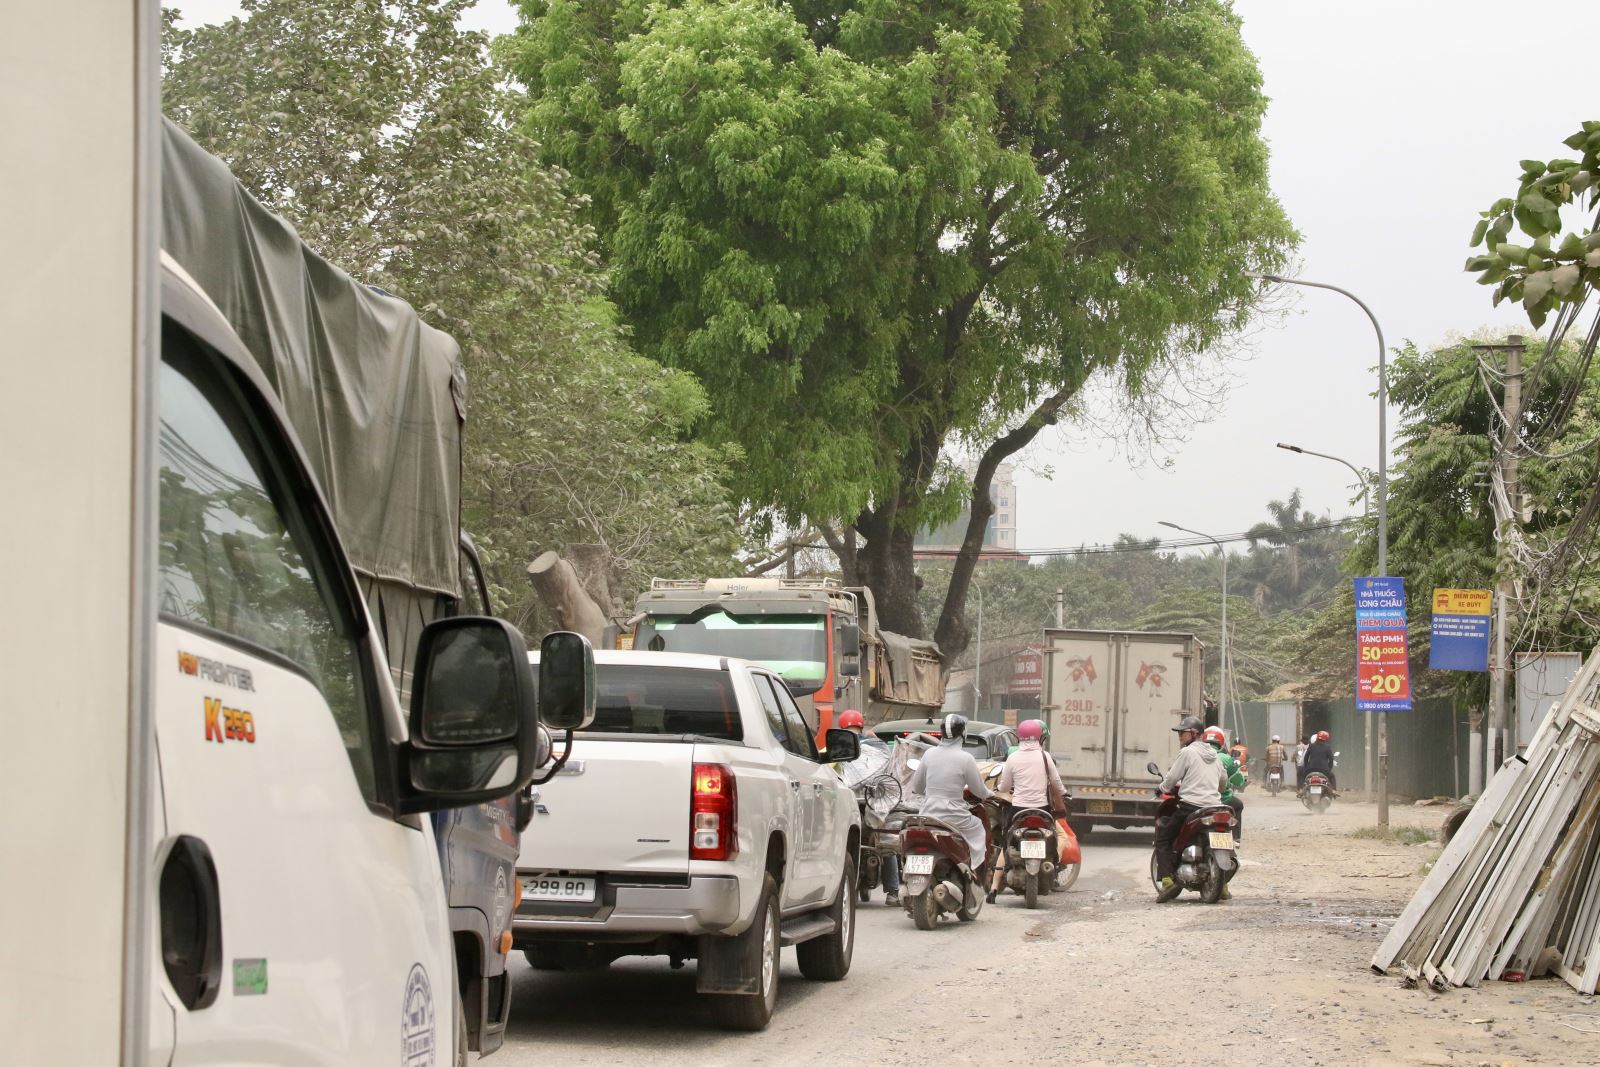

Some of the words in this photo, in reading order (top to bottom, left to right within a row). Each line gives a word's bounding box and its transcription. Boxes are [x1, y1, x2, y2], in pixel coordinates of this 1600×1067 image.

[1360, 590, 1374, 598] NHÀ
[1374, 589, 1397, 598] THUỐC
[1358, 600, 1379, 608] LONG
[1380, 598, 1402, 607] CHÂU
[1360, 633, 1381, 645] TẶNG
[1382, 635, 1404, 643] PMH
[1065, 700, 1093, 712] 29LD
[1060, 713, 1099, 727] 329.32
